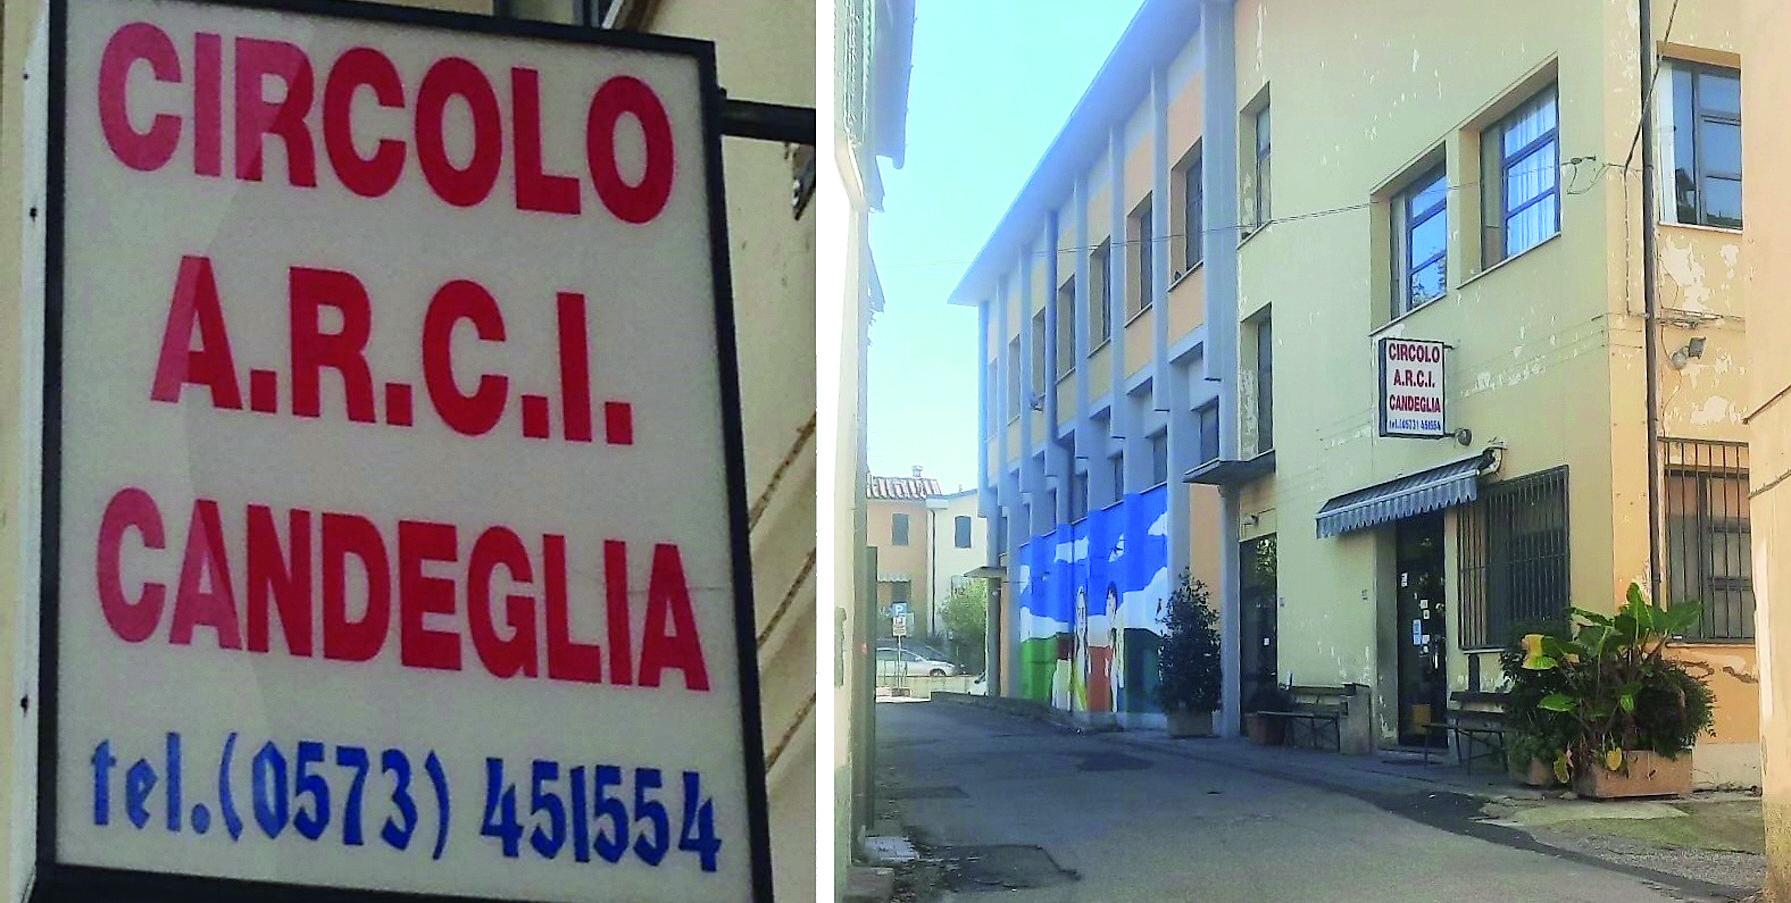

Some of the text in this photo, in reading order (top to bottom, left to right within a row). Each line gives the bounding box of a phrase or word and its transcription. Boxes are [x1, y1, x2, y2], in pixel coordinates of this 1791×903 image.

[98, 22, 676, 225] CIRCOLO
[151, 255, 634, 446] A.R.C.I.
[1388, 343, 1441, 362] CIRCOLO
[1389, 394, 1441, 413] CANDEGLIA
[1393, 369, 1435, 388] A.R.C.I.
[97, 487, 710, 692] CANDEGLIA
[480, 756, 723, 874] 451554
